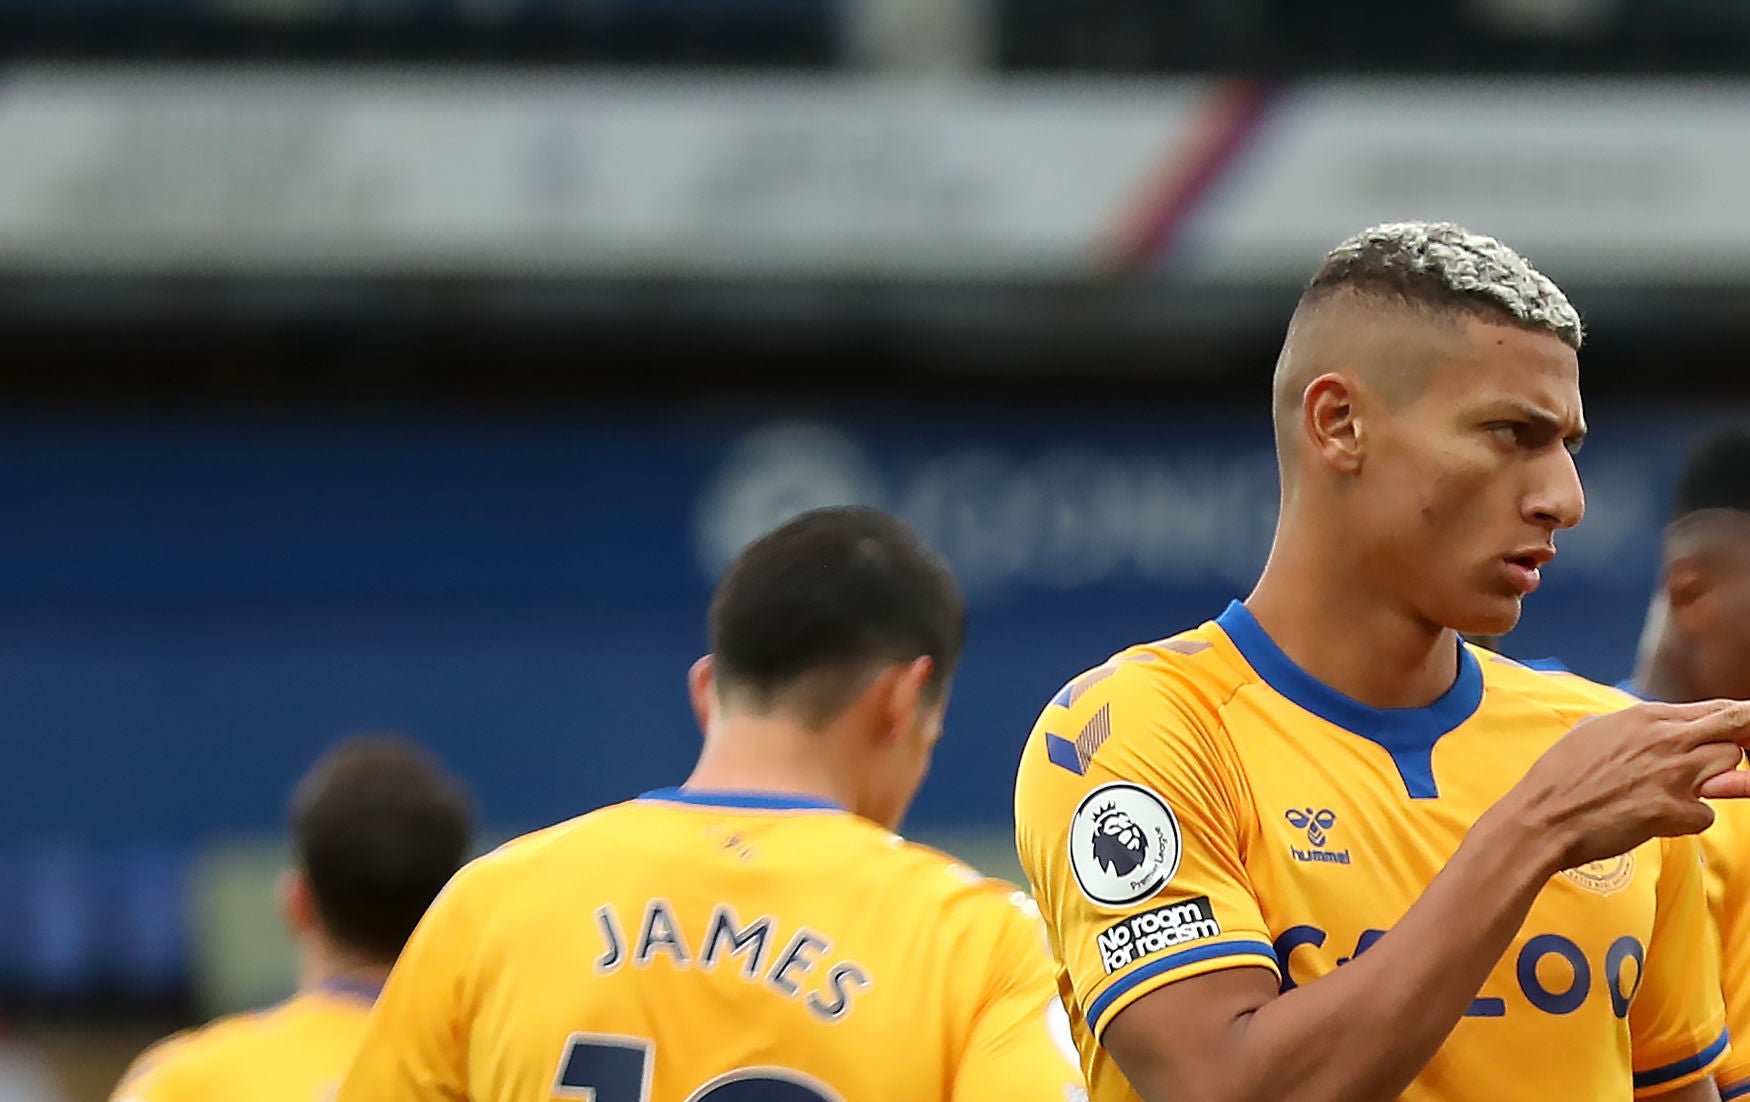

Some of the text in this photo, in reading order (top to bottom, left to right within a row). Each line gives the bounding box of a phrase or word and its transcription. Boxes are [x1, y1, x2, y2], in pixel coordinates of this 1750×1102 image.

[1290, 844, 1351, 865] hummel
[1097, 902, 1202, 952] No room
[1102, 918, 1220, 975] for racism
[591, 896, 872, 1024] JAMES
[1273, 925, 1645, 1018] COO
